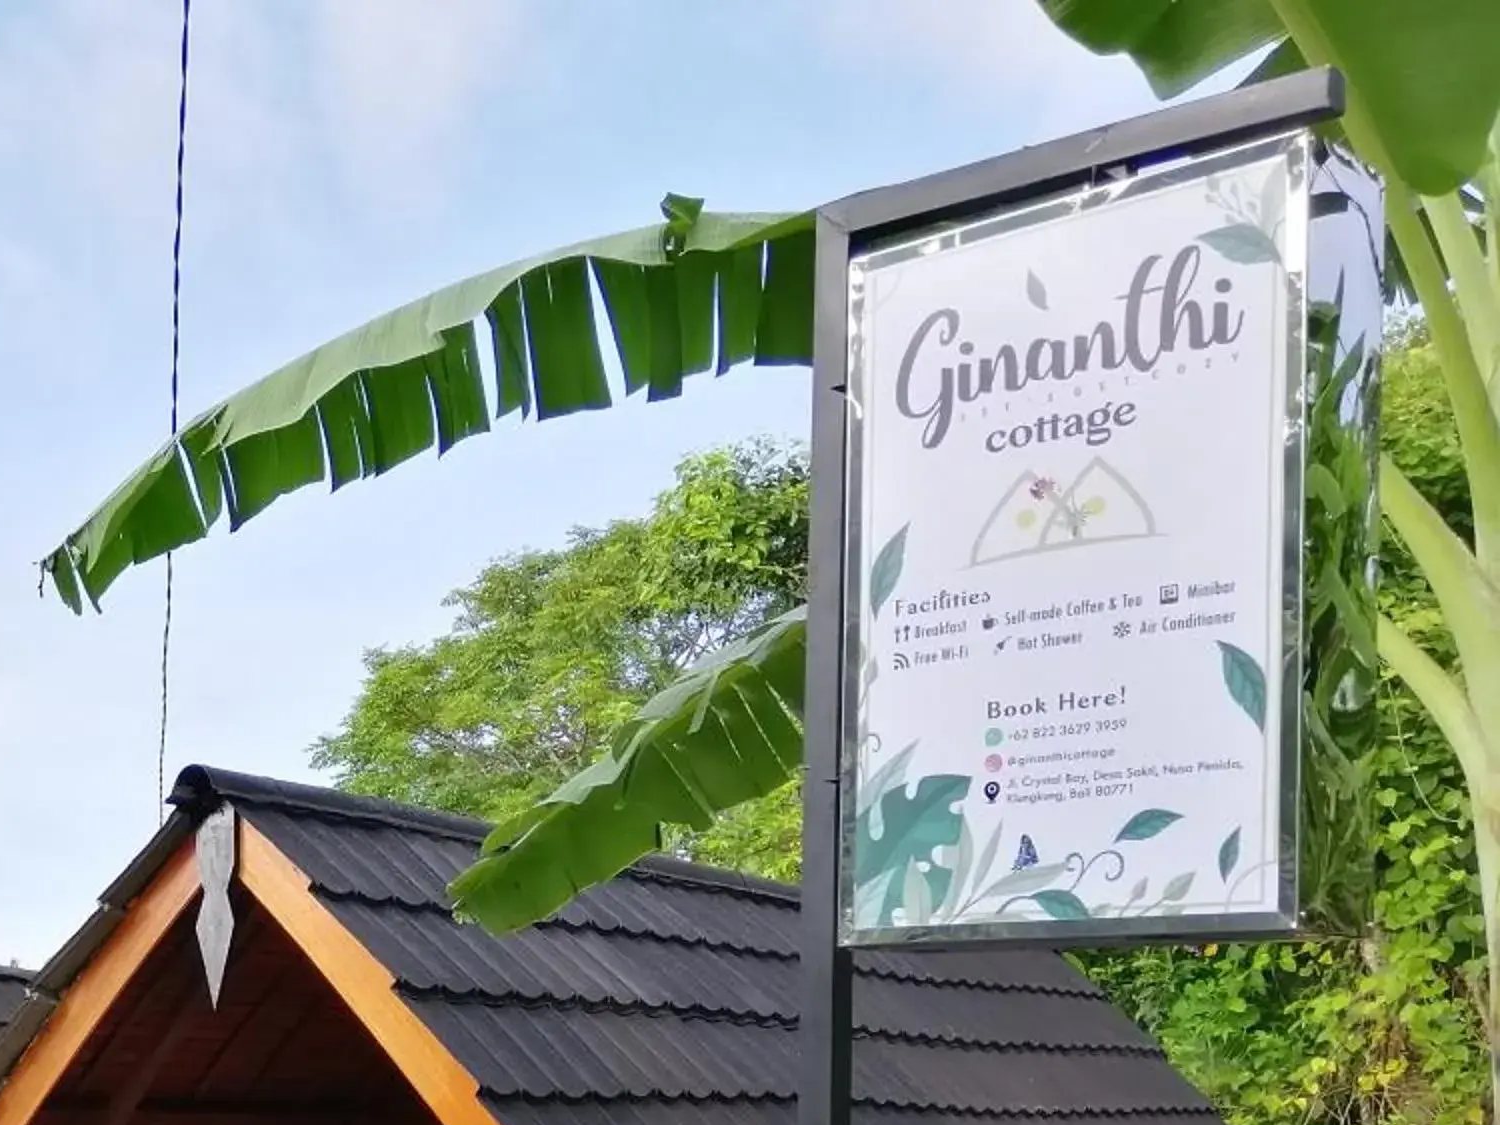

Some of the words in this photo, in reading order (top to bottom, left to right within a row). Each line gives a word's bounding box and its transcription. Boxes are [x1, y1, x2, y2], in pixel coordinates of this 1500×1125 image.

[896, 245, 1244, 449] Ginanthi
[985, 402, 1137, 453] cottage
[1187, 581, 1236, 599] Minibar
[895, 589, 991, 617] Facilities
[1005, 606, 1062, 625] Self-made
[1066, 599, 1105, 617] Coffee
[1108, 597, 1117, 611] &
[1123, 593, 1143, 608] Tea
[914, 620, 968, 639] Breakfast
[1139, 621, 1157, 635] Air
[1162, 611, 1236, 632] Conditioner
[1017, 637, 1038, 650] Hot
[1041, 631, 1083, 649] Shower
[914, 651, 937, 666] Free
[941, 645, 969, 661] Wi-Fi
[987, 697, 1047, 720] Book
[1059, 685, 1126, 711] Here!
[1021, 774, 1061, 788] Crystal
